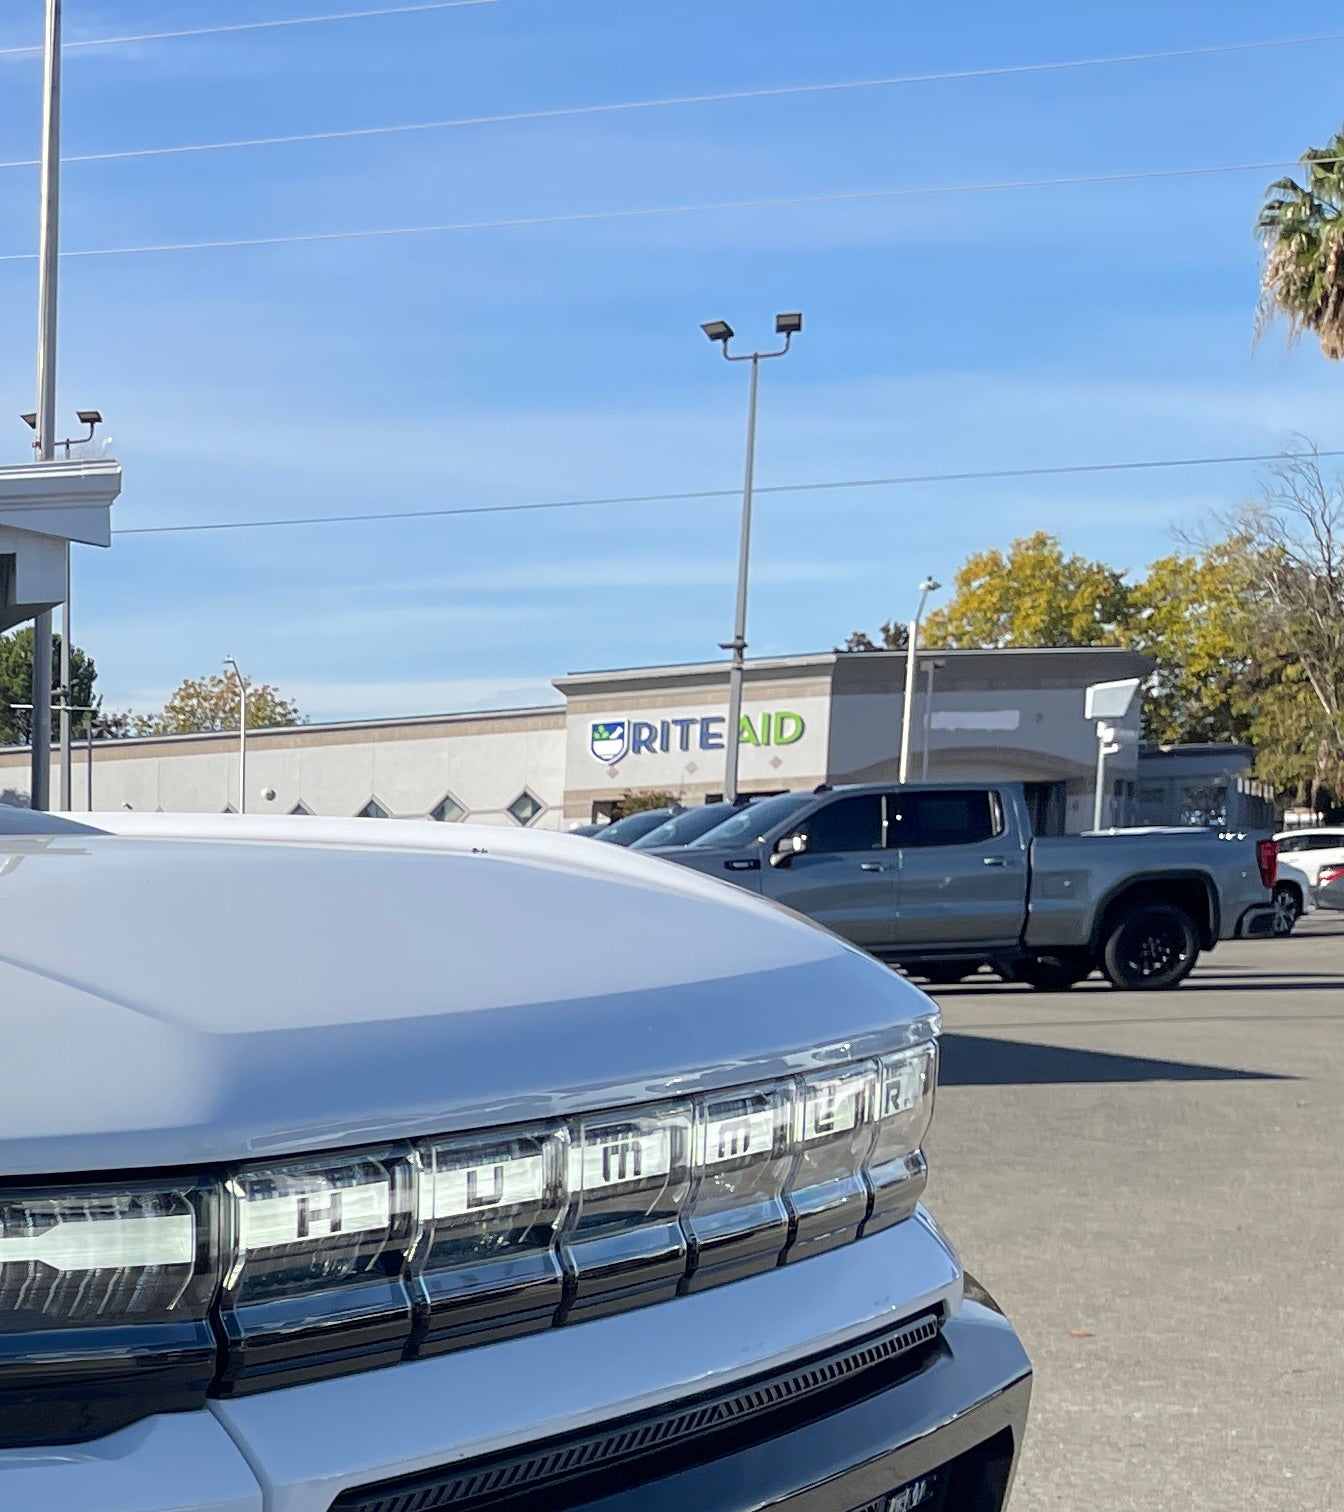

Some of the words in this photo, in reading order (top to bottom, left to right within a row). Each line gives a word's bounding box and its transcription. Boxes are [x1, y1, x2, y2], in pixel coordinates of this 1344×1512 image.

[632, 715, 726, 755] RITE
[738, 711, 805, 747] AID
[296, 1078, 906, 1238] HUMMER
